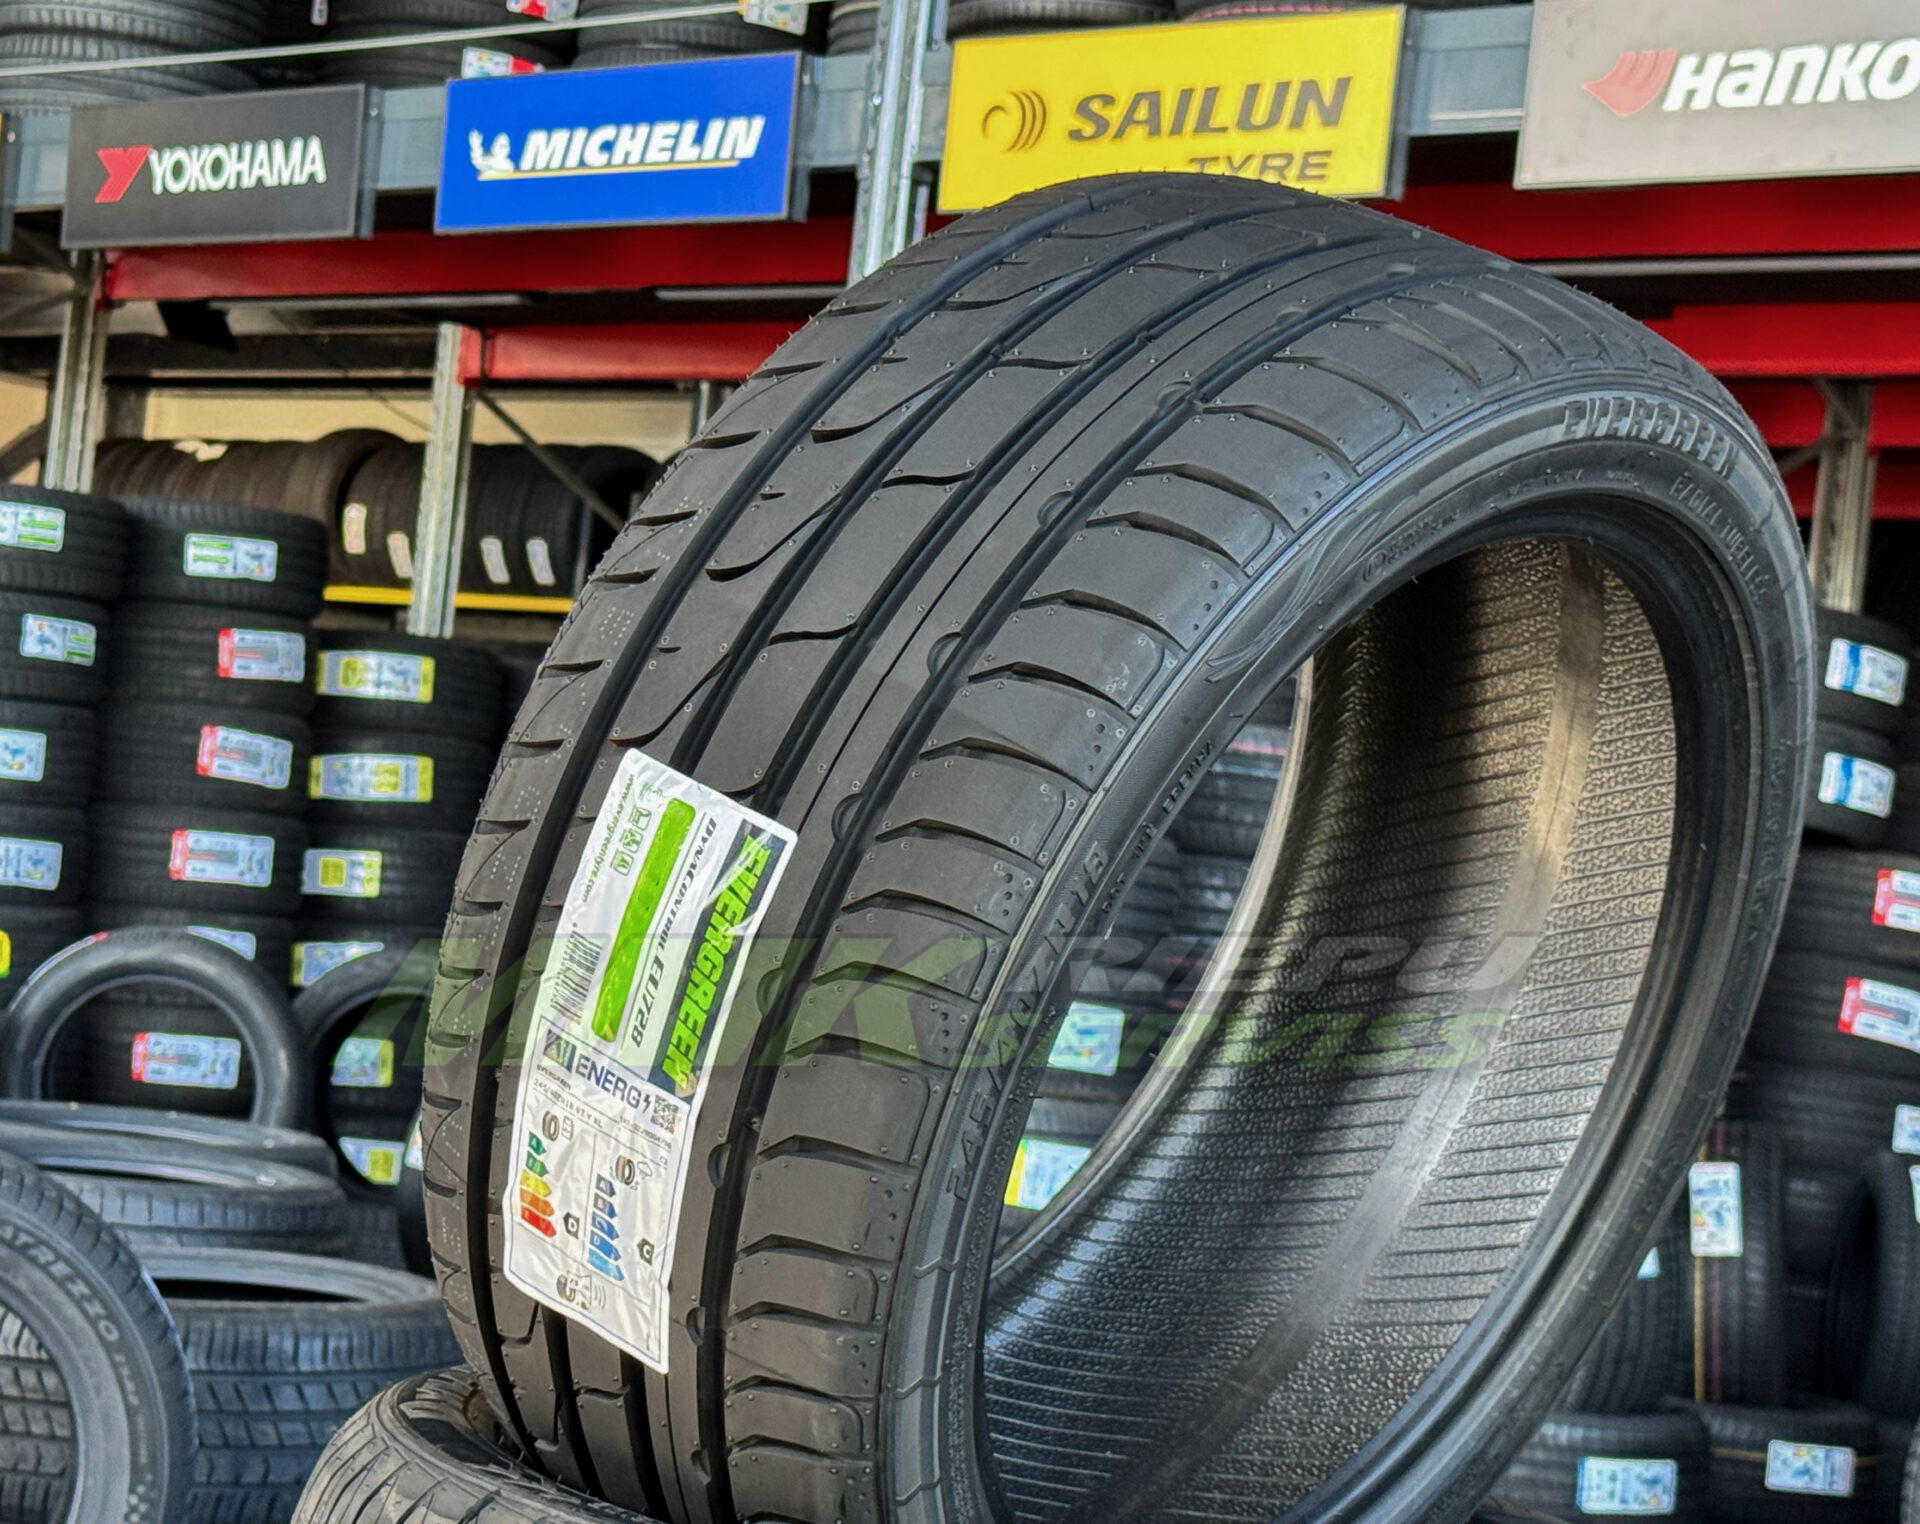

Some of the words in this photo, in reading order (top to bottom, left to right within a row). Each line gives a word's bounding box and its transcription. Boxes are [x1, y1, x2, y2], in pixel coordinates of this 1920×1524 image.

[1067, 76, 1353, 142] SAILUN
[149, 135, 327, 195] YOKOHAMA
[520, 115, 766, 171] MICHELIN
[1188, 149, 1333, 182] TYRE
[1562, 393, 1737, 478] EVERGREEN
[660, 834, 772, 1090] EVERGREEN
[630, 954, 665, 1049] EU728
[945, 840, 1110, 1200] 245/40ZR18
[575, 1052, 642, 1110] ENERG
